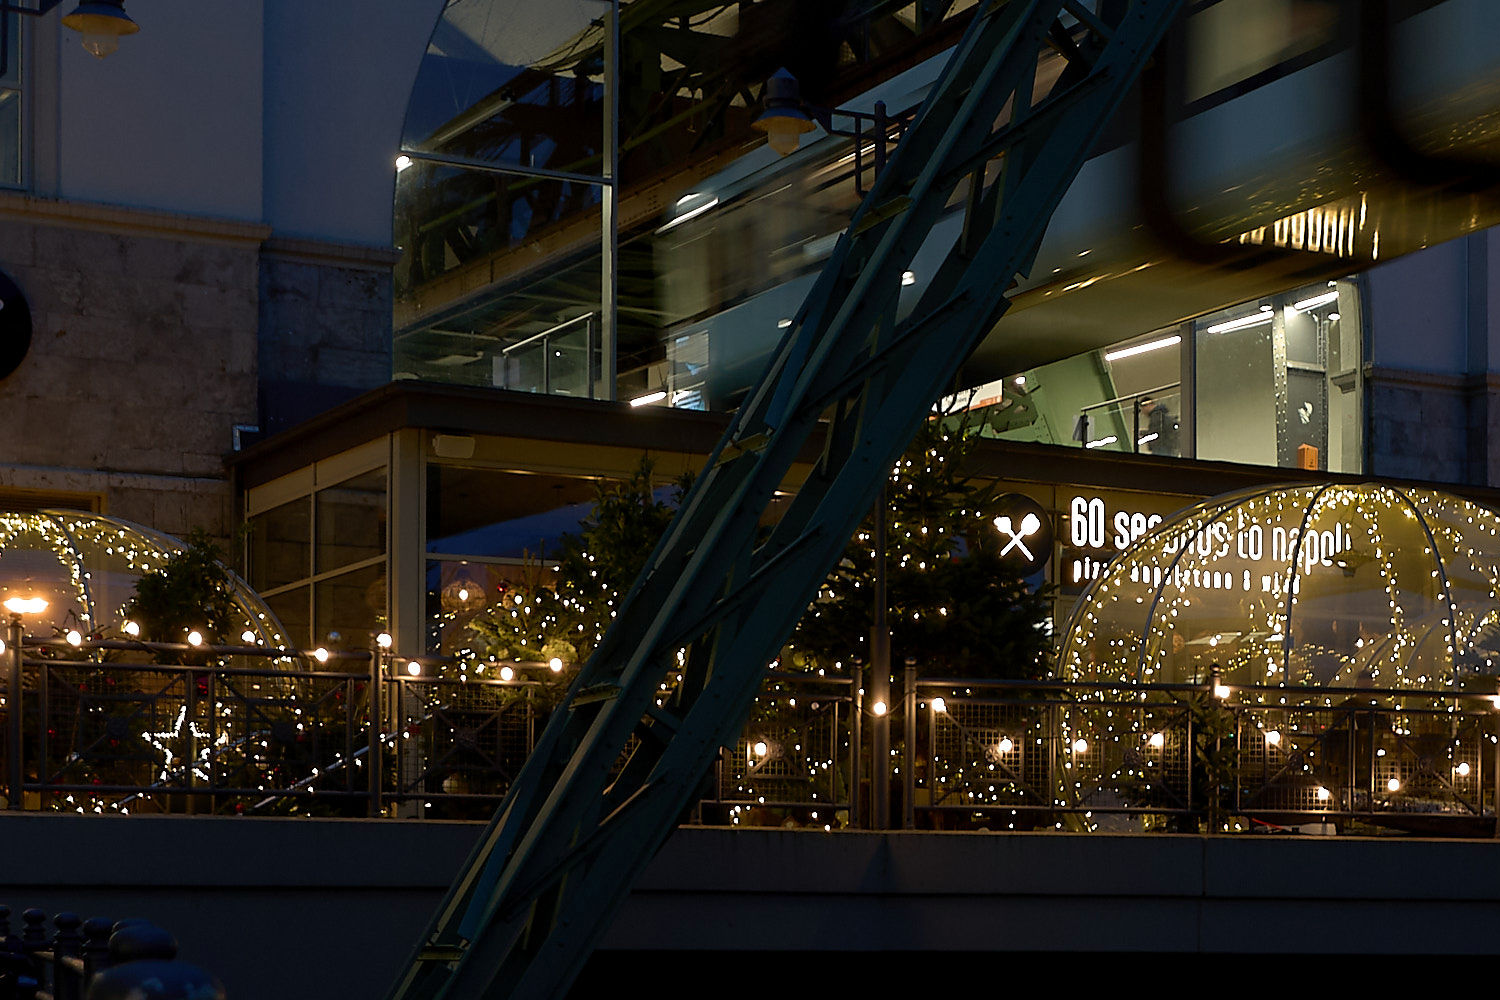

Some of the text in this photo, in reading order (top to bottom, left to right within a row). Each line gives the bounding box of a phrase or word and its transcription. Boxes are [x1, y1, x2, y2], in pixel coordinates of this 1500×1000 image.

[1070, 496, 1105, 548] 60
[1237, 508, 1263, 561] to
[1271, 521, 1353, 576] napoli
